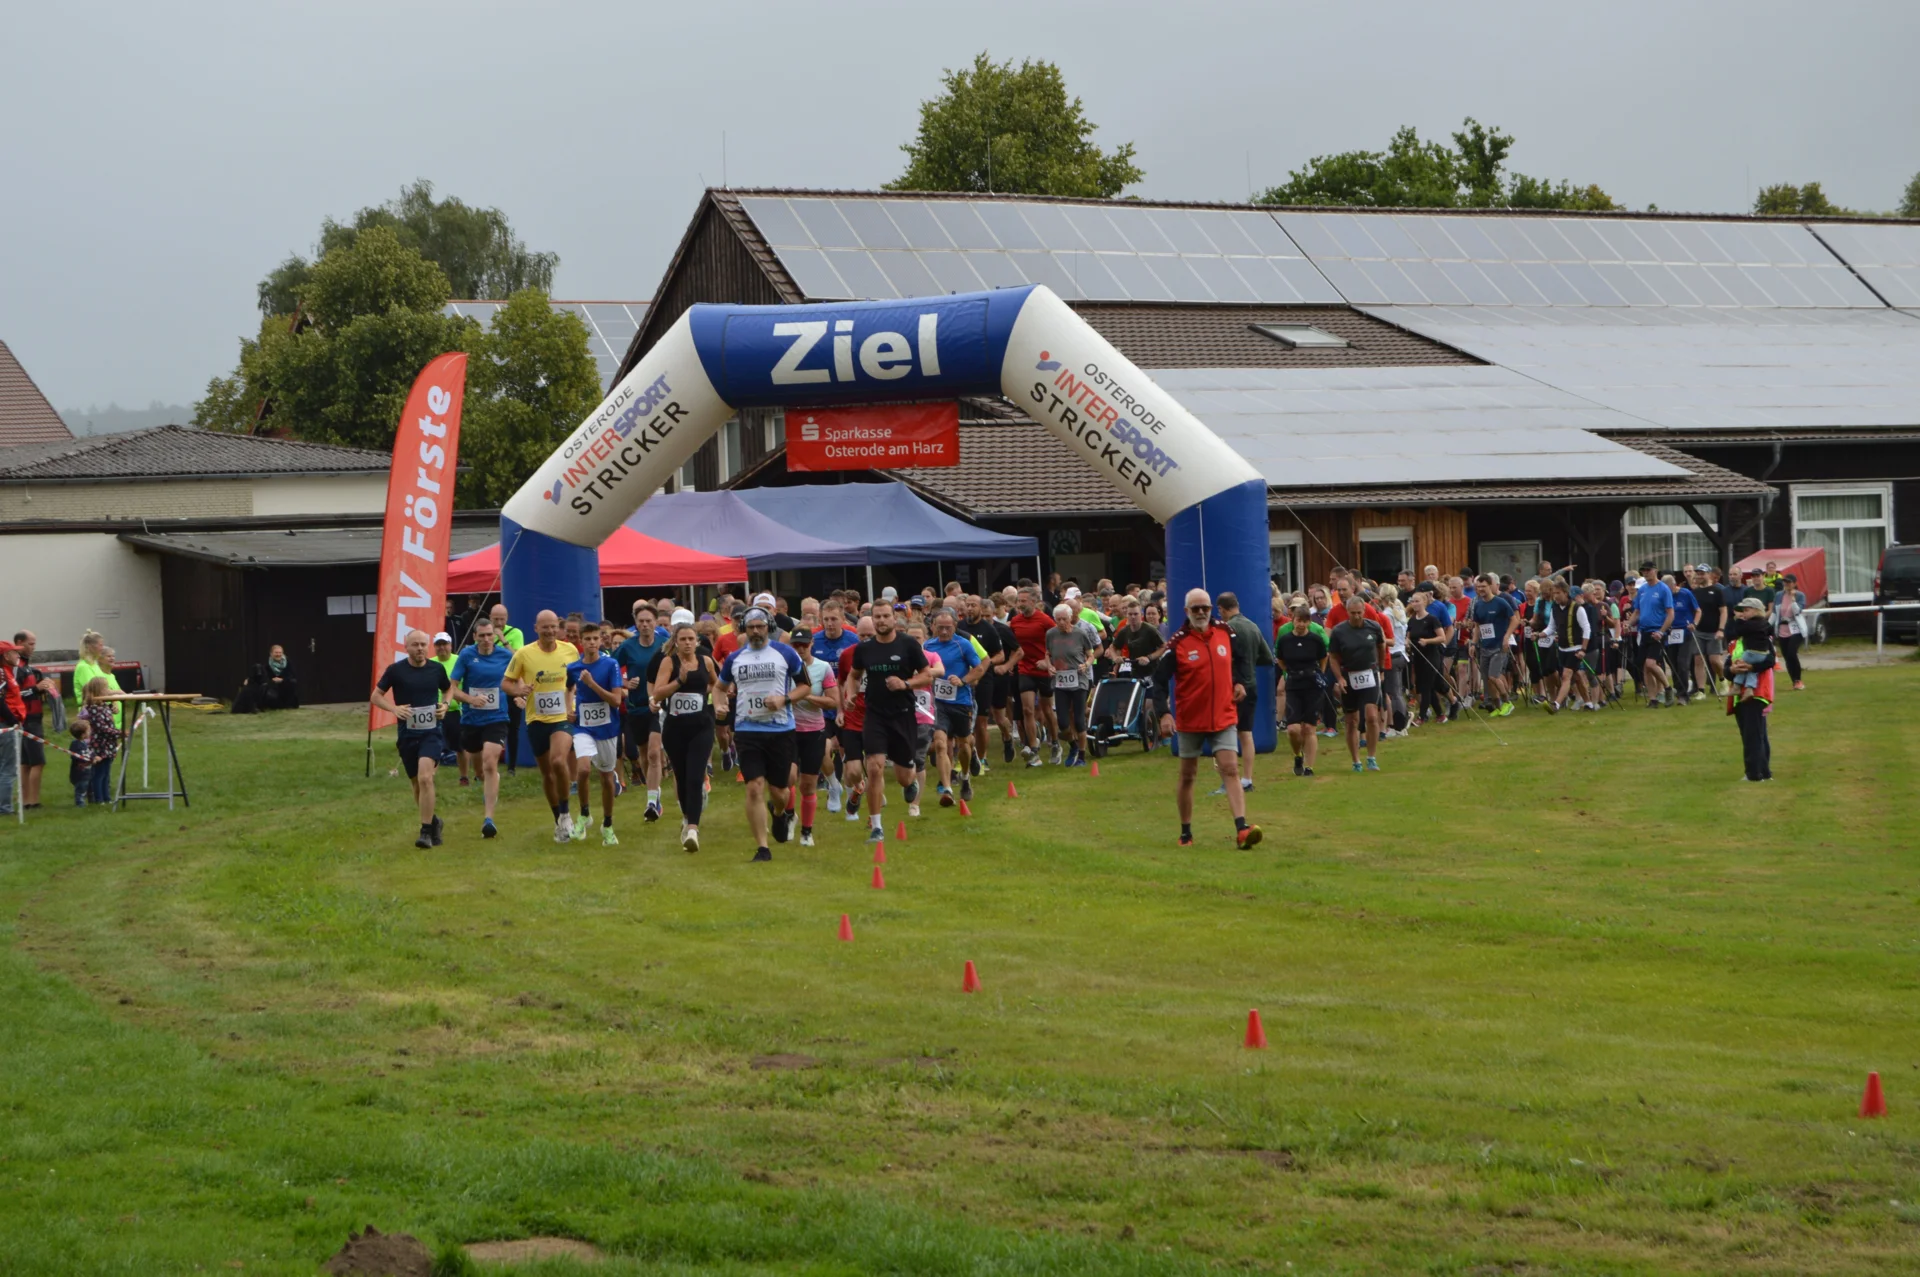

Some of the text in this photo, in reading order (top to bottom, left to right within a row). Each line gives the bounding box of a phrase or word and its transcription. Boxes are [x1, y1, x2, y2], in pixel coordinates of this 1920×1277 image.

[771, 313, 941, 385] Ziel
[1084, 363, 1166, 435] OSTERODE
[563, 385, 634, 459] OSTERODE
[1054, 368, 1179, 477] INTERSPORT
[562, 373, 672, 488] INTERSPORT
[824, 426, 892, 442] Sparkasse
[1030, 382, 1152, 495] STRICKER
[824, 441, 944, 458] Osterode am Harz
[571, 401, 689, 516] STRICKER
[402, 385, 451, 563] Förste
[748, 662, 776, 671] FINISHER
[748, 670, 776, 680] HAMBURG
[1058, 675, 1075, 683] 210
[1353, 674, 1370, 685] 197
[935, 684, 953, 695] 153
[538, 697, 560, 709] 034
[675, 699, 698, 711] 008
[412, 712, 433, 724] 103
[583, 708, 606, 721] 035
